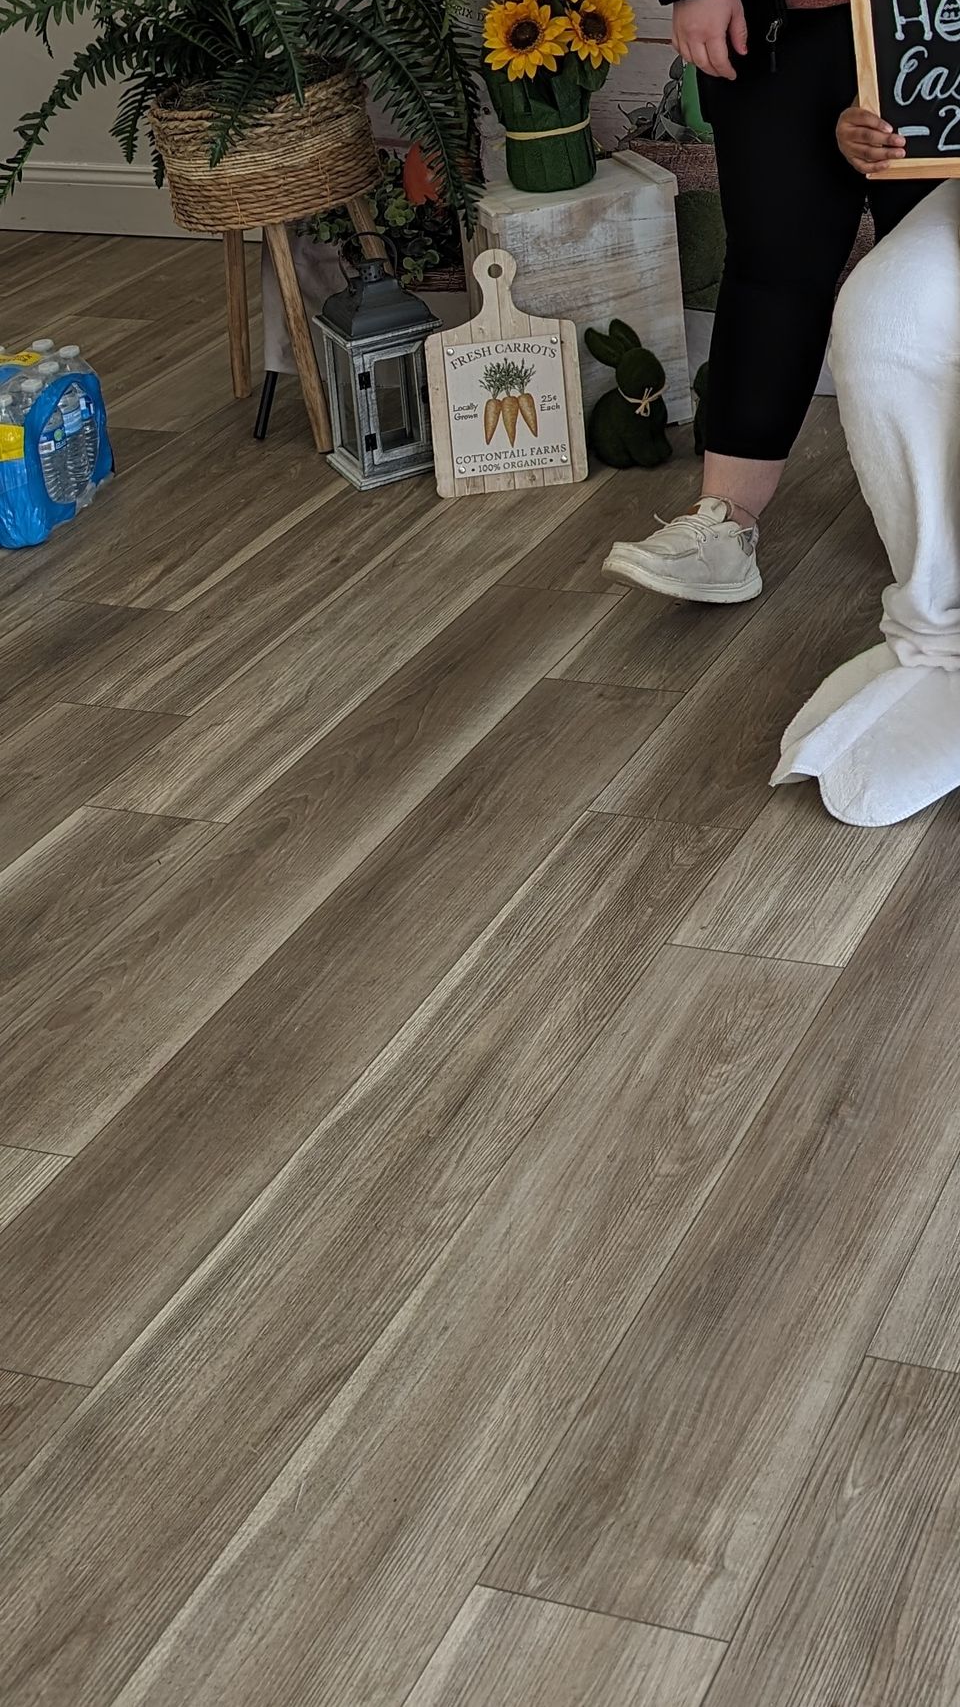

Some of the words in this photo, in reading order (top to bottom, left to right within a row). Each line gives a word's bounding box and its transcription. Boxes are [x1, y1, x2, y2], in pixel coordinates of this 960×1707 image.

[450, 346, 492, 370] FRESH
[494, 343, 558, 359] CARROTS
[452, 403, 479, 412] Locally
[540, 403, 561, 412] Each
[453, 412, 479, 421] Grown
[455, 448, 527, 465] COTTONTAIL
[530, 443, 567, 456] FARMS
[478, 463, 501, 473] 100%
[503, 457, 547, 470] ORGANIC
